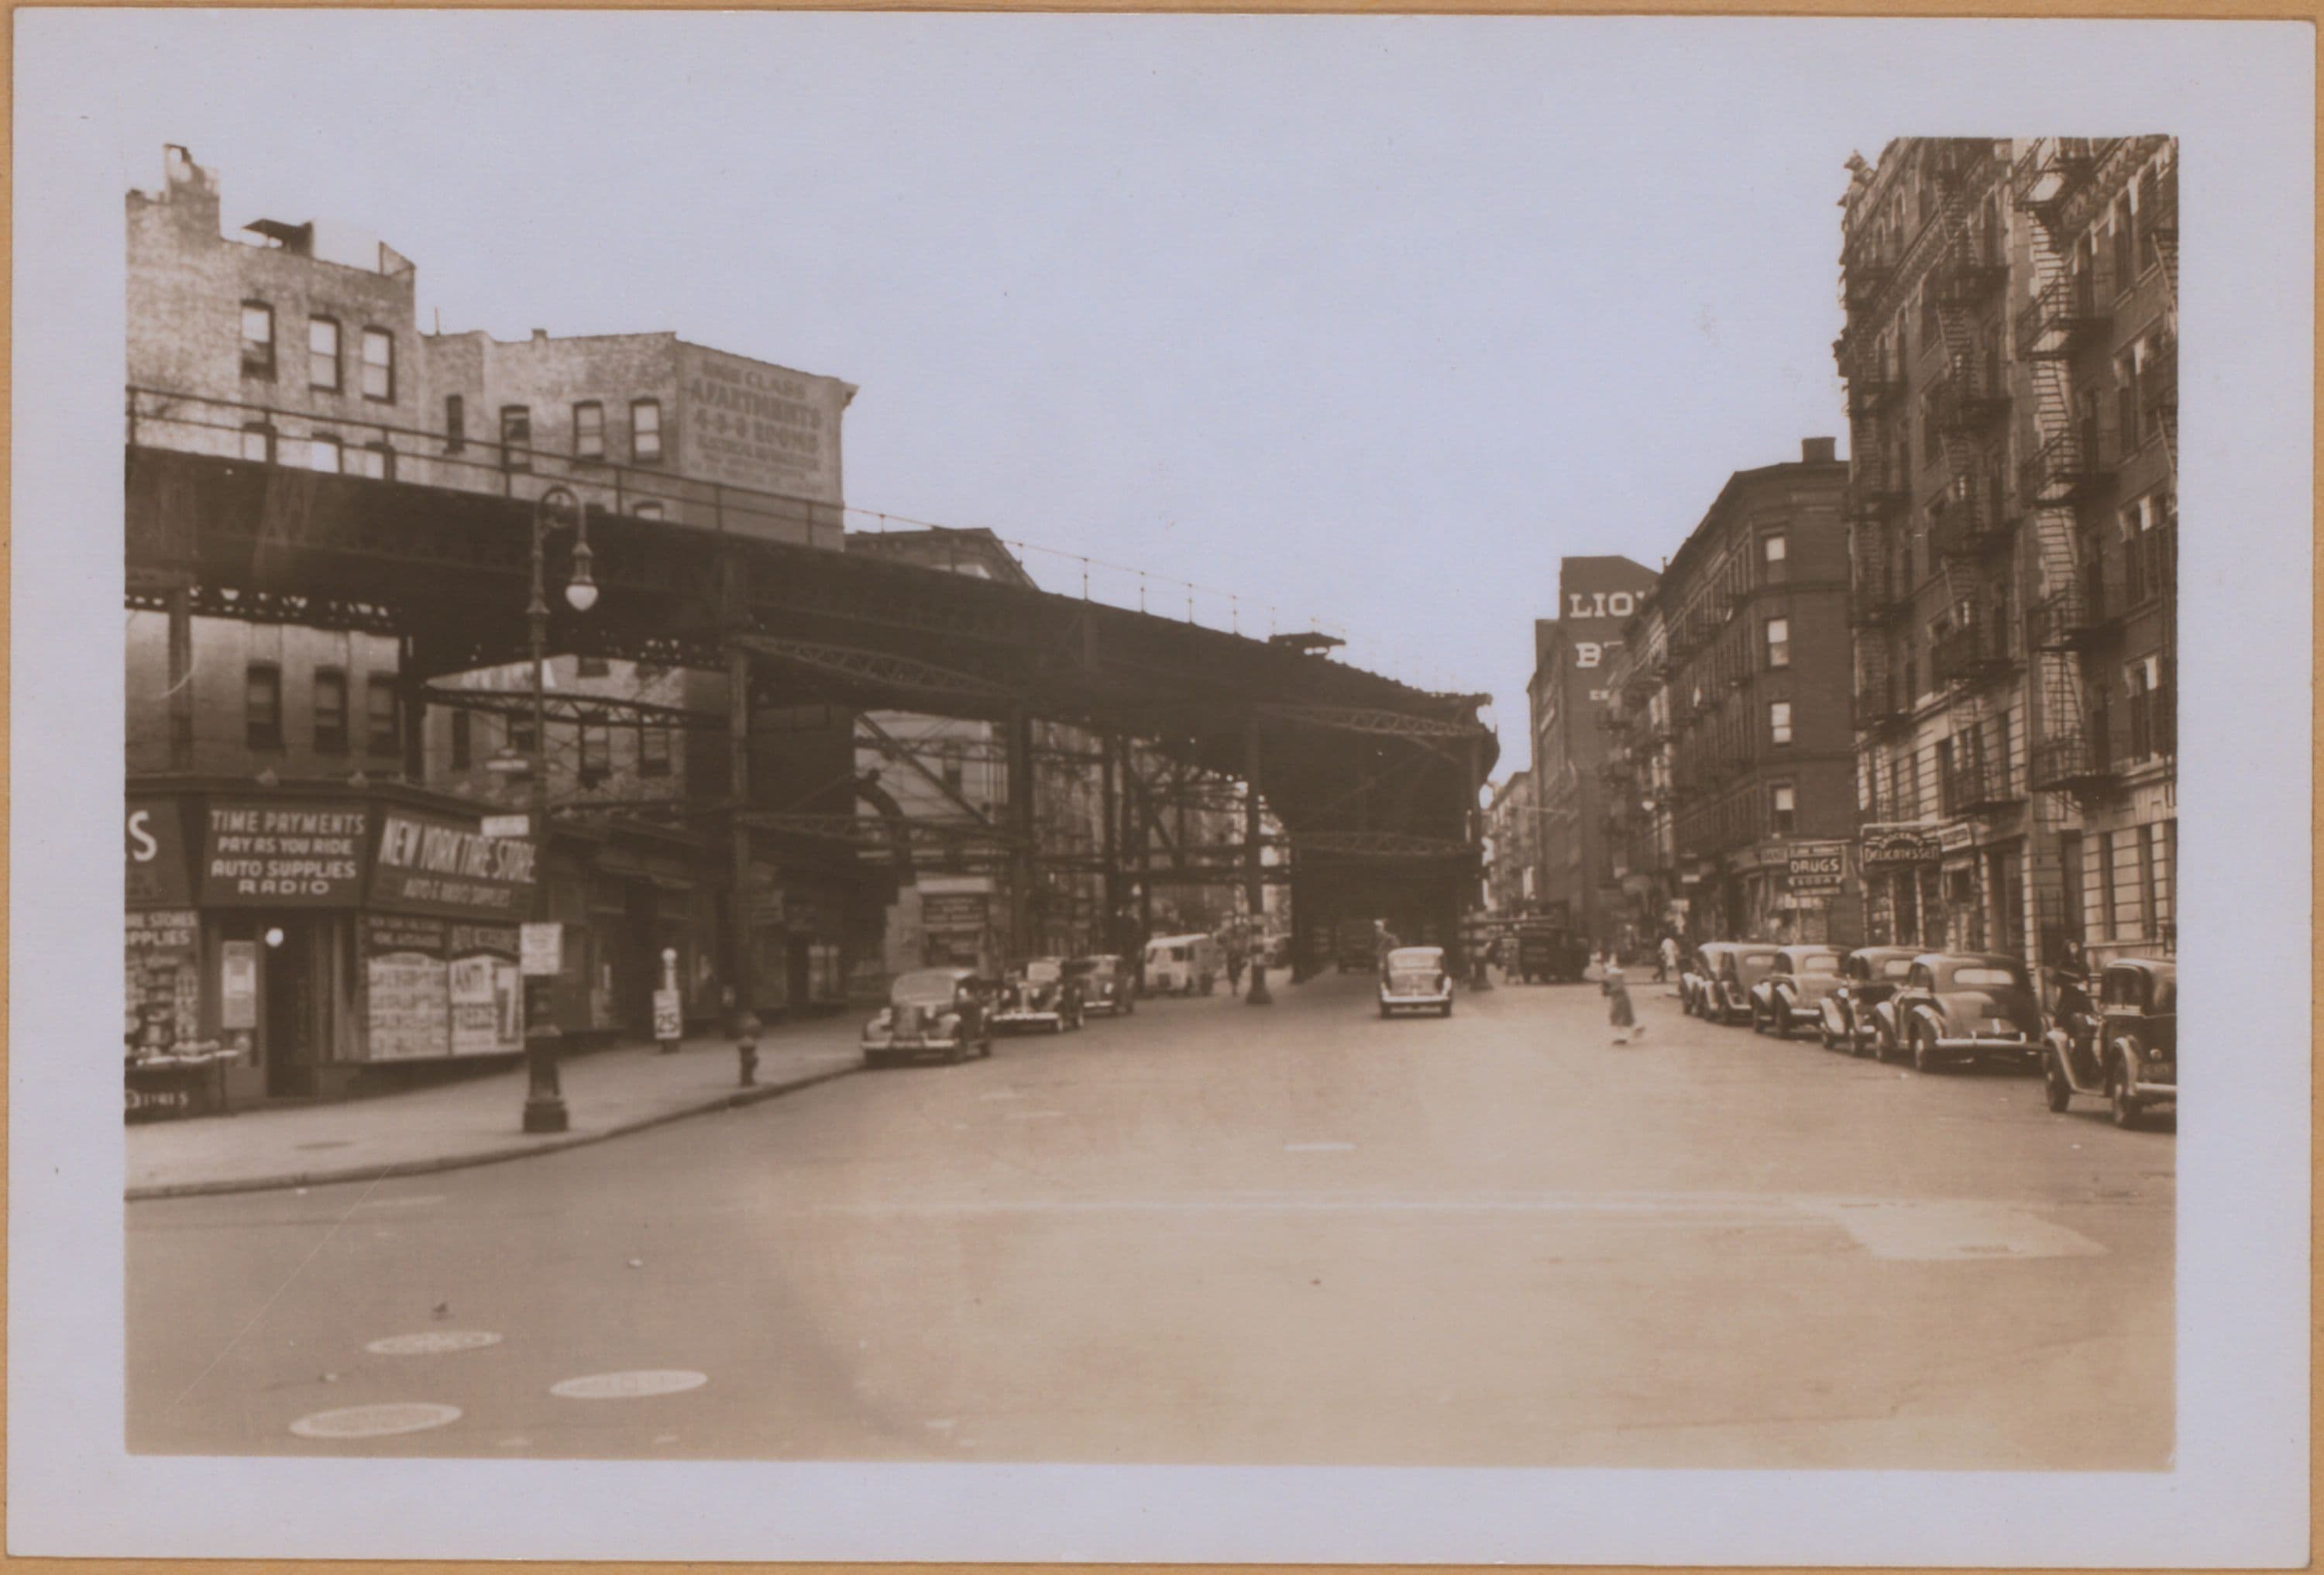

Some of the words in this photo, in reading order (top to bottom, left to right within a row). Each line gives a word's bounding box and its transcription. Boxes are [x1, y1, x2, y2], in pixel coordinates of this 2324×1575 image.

[745, 371, 806, 400] CLASS
[689, 377, 820, 431] APARTMENTS
[1569, 591, 1645, 617] LIO
[211, 810, 259, 832] TIME
[265, 812, 365, 834] PAYMENTS
[126, 810, 157, 861] S
[218, 837, 251, 852] PAY
[254, 837, 276, 853] AS
[280, 838, 310, 854] YOU
[313, 838, 353, 855] RIDE
[378, 818, 423, 868] NEW
[421, 825, 463, 875] YORK
[458, 831, 496, 879] TIRE
[491, 839, 537, 885] STORE
[1864, 846, 1939, 863] DELICATESSEN
[211, 859, 262, 877] AUTO
[266, 860, 356, 879] SUPPLIES
[1790, 858, 1839, 874] DRUGS
[238, 878, 330, 894] RADIO
[657, 1012, 679, 1033] 25
